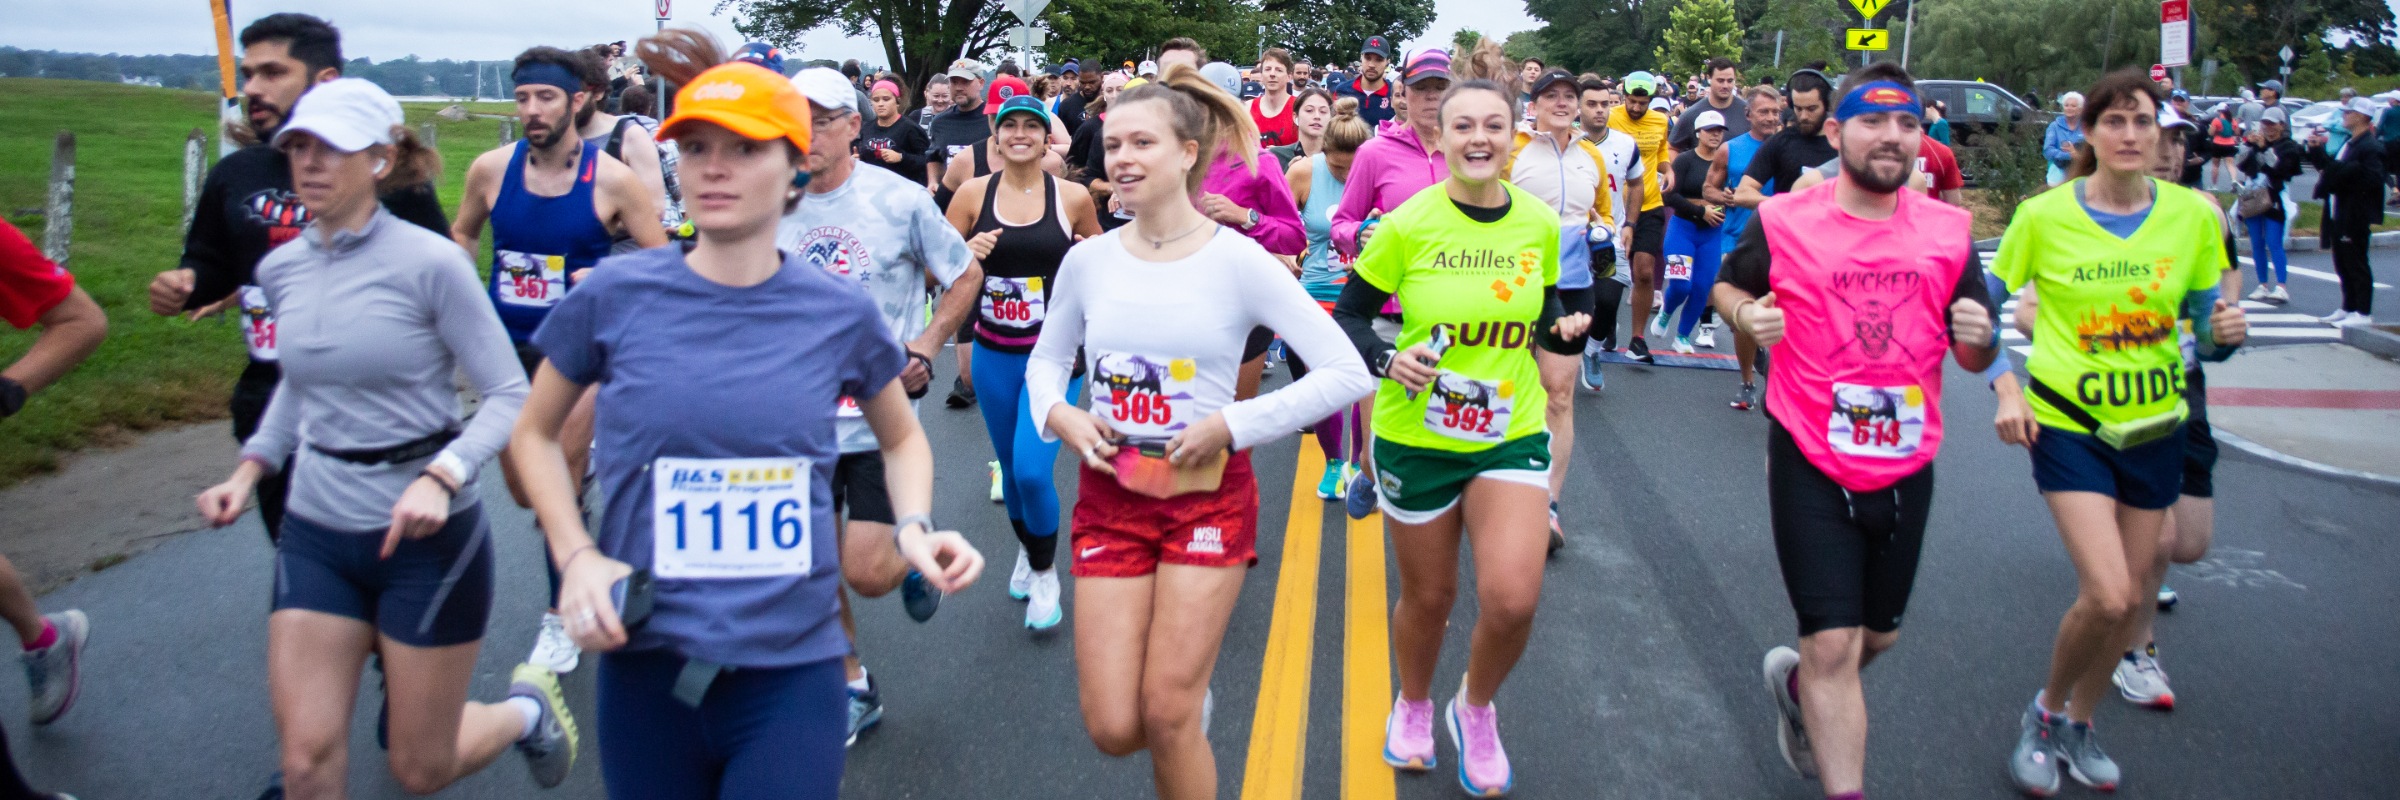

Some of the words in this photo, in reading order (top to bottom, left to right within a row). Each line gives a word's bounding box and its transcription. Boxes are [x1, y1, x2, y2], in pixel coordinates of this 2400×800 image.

[2151, 69, 2165, 77] STOP
[803, 226, 849, 243] ROTARY
[848, 237, 870, 267] CLUB
[1432, 249, 1515, 269] Achilles
[1833, 271, 1920, 292] WICKED
[2073, 260, 2151, 283] Achilles
[993, 299, 1030, 321] 606
[2077, 361, 2182, 406] GUIDE
[1111, 389, 1172, 425] 505
[1443, 402, 1494, 433] 592
[1852, 419, 1901, 447] 614
[666, 498, 803, 550] 1116
[1193, 527, 1222, 541] WSU
